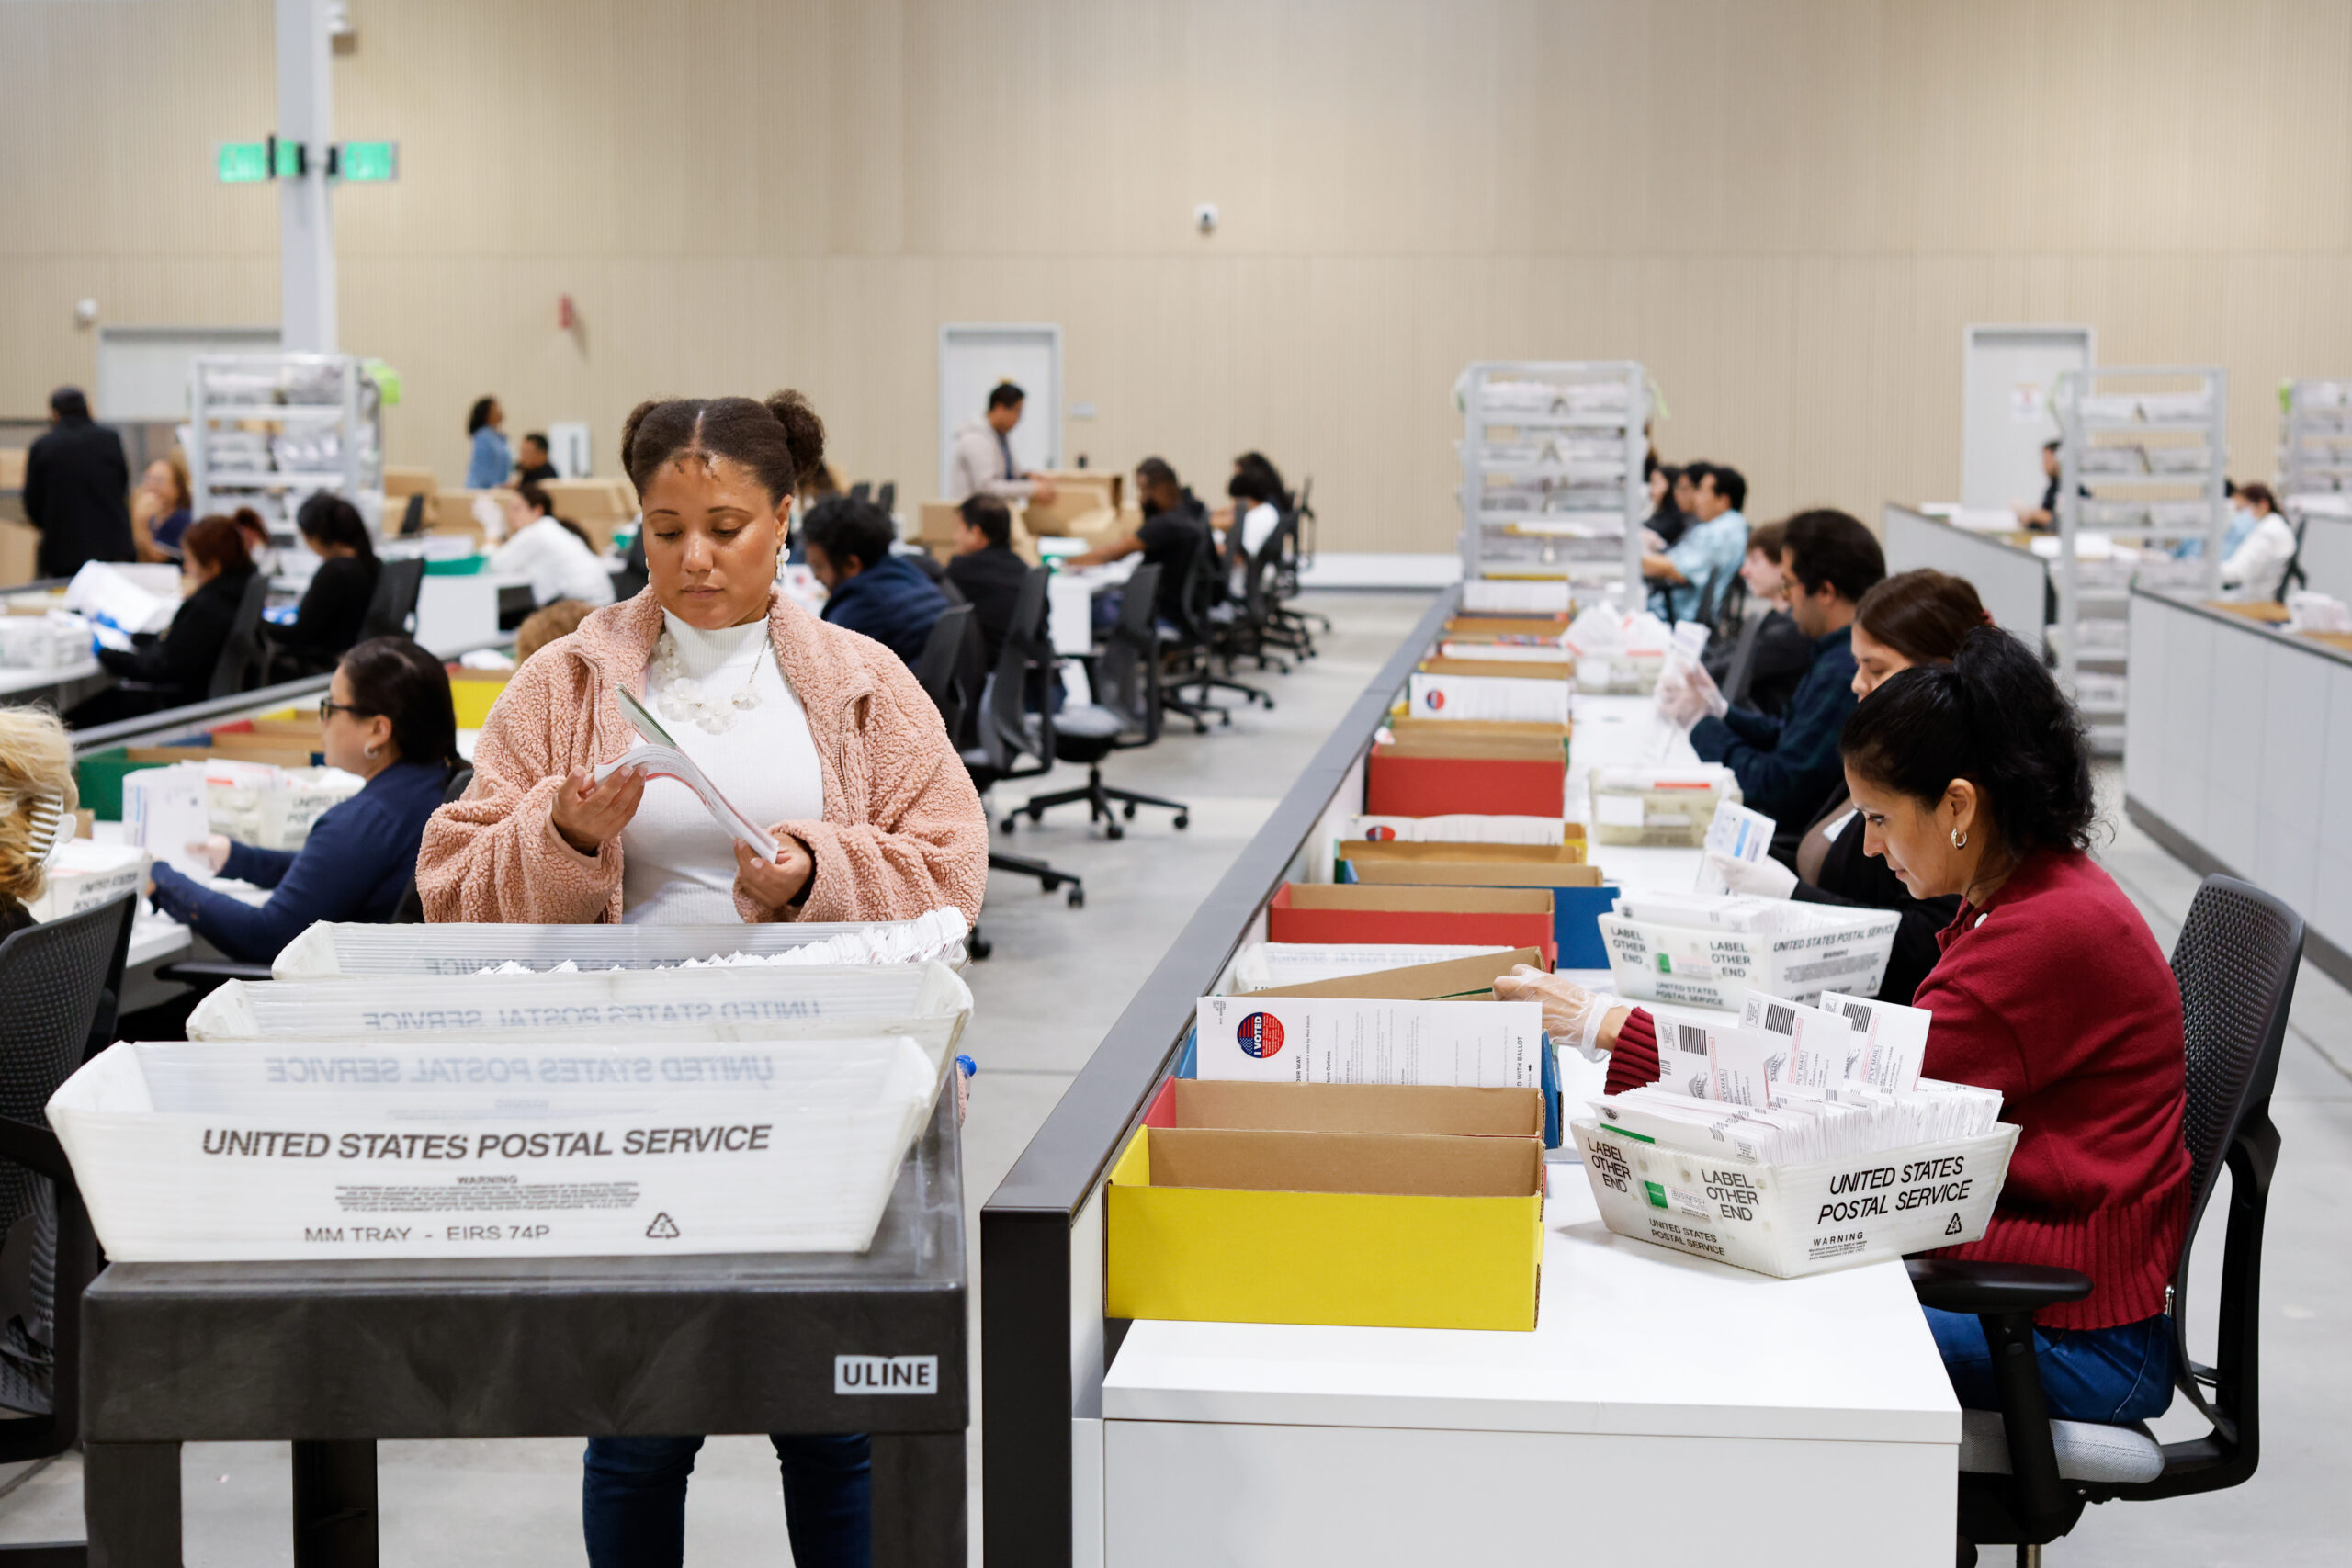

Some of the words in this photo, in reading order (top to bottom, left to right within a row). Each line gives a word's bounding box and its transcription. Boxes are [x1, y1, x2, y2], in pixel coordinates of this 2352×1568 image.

[1611, 926, 1644, 941] LABEL
[1773, 939, 1805, 952] UNITED
[1806, 935, 1836, 948] STATES
[1837, 930, 1865, 942] POSTAL
[1867, 923, 1895, 938] SERVICE
[1612, 939, 1647, 953] OTHER
[1710, 941, 1748, 953] LABEL
[1623, 953, 1643, 964] END
[1711, 953, 1751, 965] OTHER
[1722, 966, 1747, 978] END
[1656, 981, 1685, 992] UNITED
[1687, 986, 1718, 996] STATES
[1656, 990, 1687, 1002] POSTAL
[1689, 994, 1724, 1006] SERVICE
[1253, 1016, 1262, 1049] VOTED
[202, 1129, 331, 1158] UNITED
[338, 1133, 469, 1159] STATES
[476, 1131, 613, 1159] POSTAL
[622, 1124, 773, 1155] SERVICE
[1587, 1137, 1627, 1165] LABEL
[1591, 1155, 1632, 1181] OTHER
[1830, 1167, 1896, 1195] UNITED
[1900, 1156, 1965, 1184] STATES
[457, 1175, 519, 1186] WARNING
[1601, 1173, 1628, 1193] END
[1701, 1168, 1755, 1189] LABEL
[1706, 1186, 1759, 1205] OTHER
[1817, 1195, 1889, 1224] POSTAL
[1895, 1179, 1973, 1211] SERVICE
[1720, 1203, 1753, 1222] END
[305, 1227, 344, 1243] MM
[350, 1226, 412, 1243] TRAY
[447, 1225, 502, 1242] EIRS
[508, 1224, 550, 1240] 74P
[1648, 1218, 1681, 1235] UNITED
[1682, 1227, 1718, 1244] STATES
[1813, 1231, 1864, 1247] WARNING
[1650, 1229, 1686, 1246] POSTAL
[1686, 1237, 1726, 1257] SERVICE
[843, 1362, 930, 1386] ULINE
